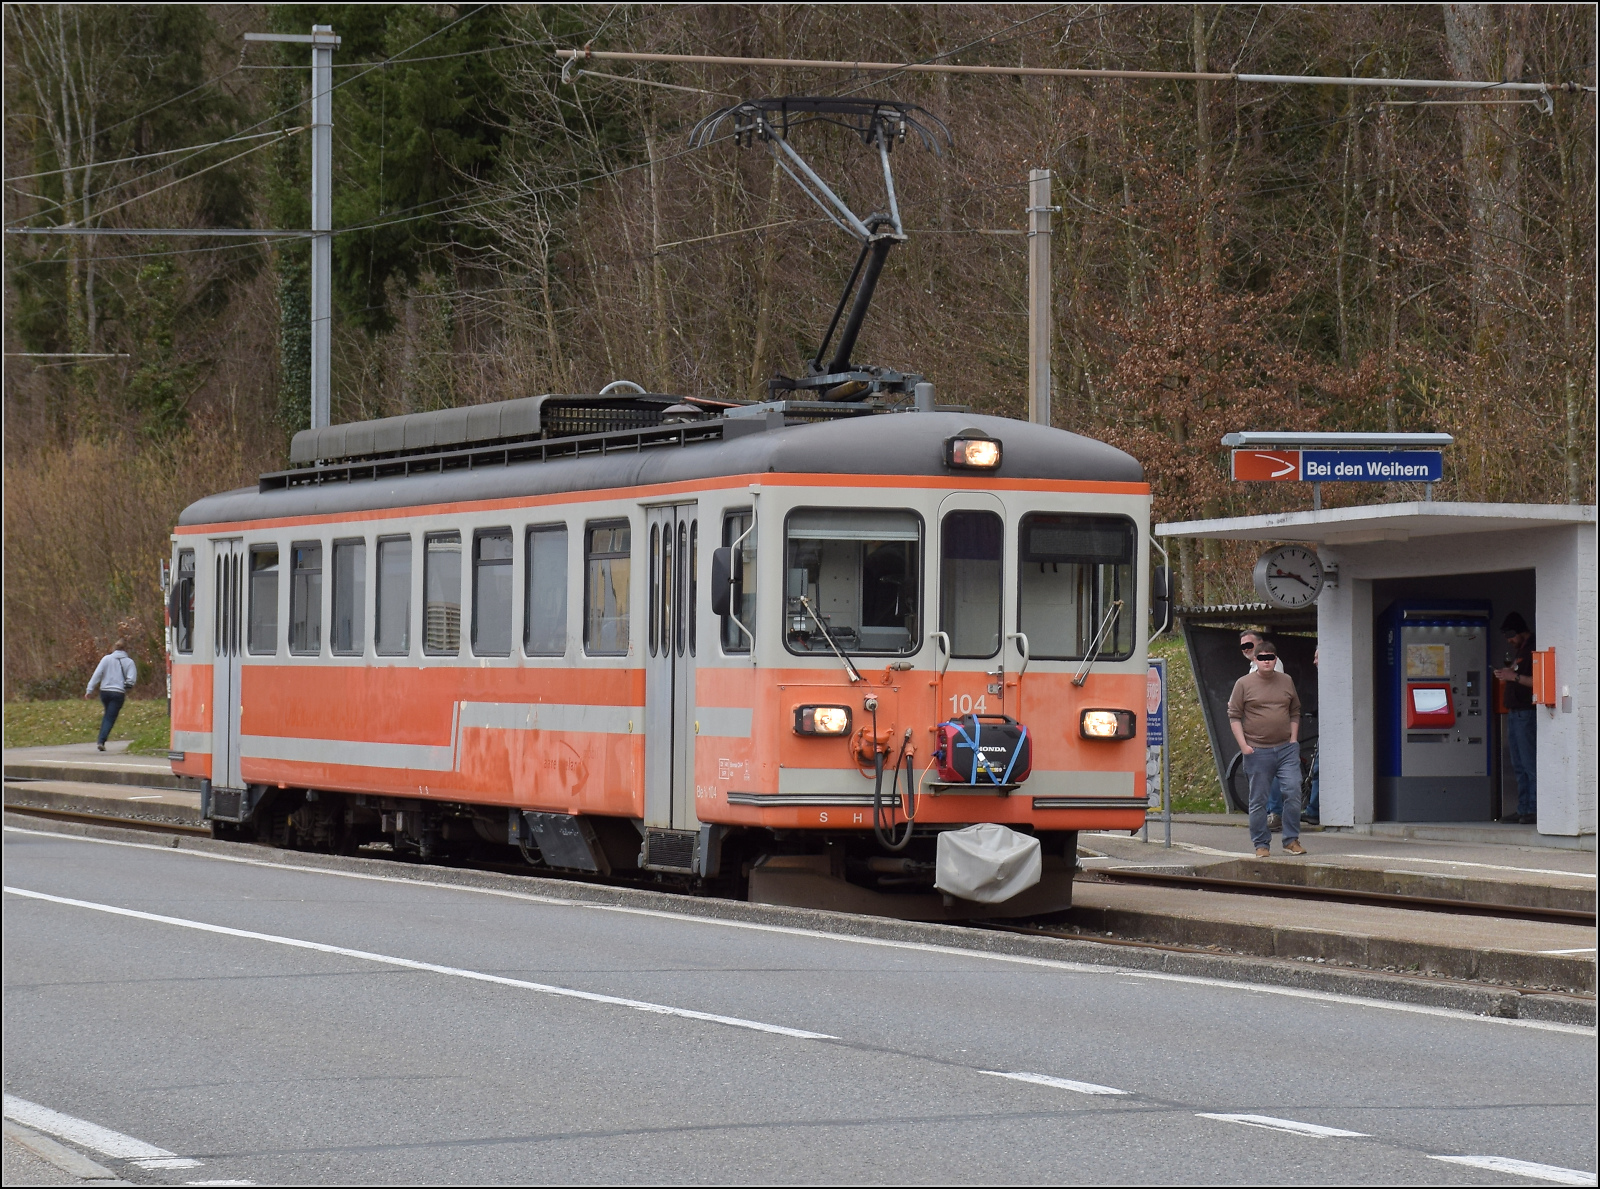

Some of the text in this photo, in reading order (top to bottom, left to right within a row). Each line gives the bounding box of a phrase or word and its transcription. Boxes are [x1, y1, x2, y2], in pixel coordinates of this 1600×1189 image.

[1307, 461, 1429, 476] Bei den Weihern
[949, 694, 987, 714] 104
[819, 811, 863, 823] S H
